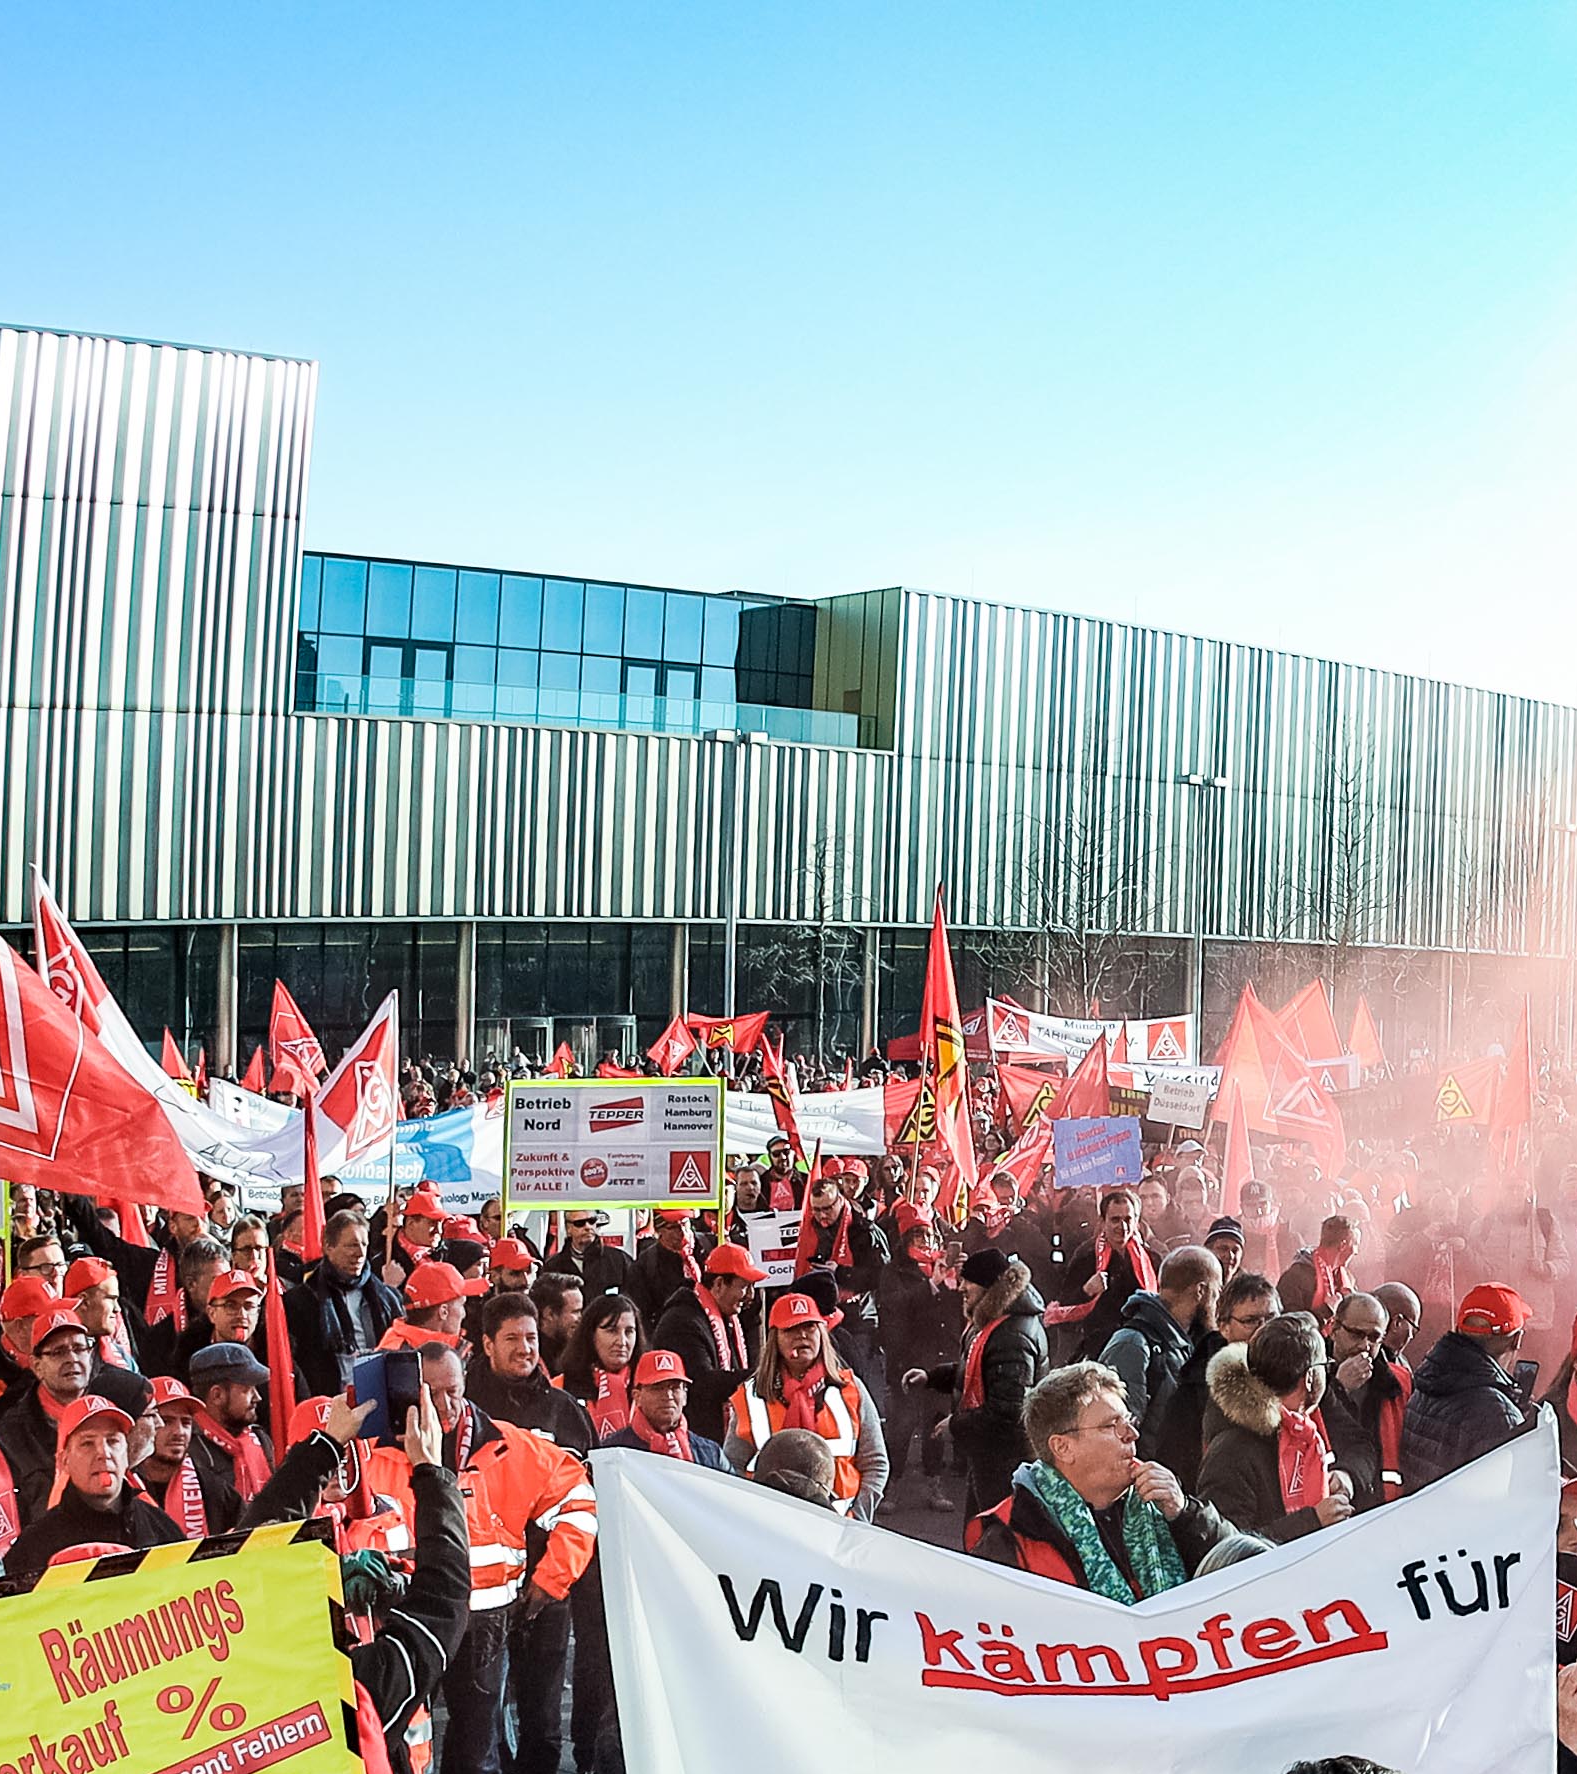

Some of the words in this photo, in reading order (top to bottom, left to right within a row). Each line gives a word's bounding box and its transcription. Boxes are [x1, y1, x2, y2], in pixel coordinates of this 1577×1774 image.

[515, 1098, 572, 1110] Betrieb
[667, 1095, 711, 1103] Rostock
[589, 1110, 644, 1120] TEPPER
[665, 1108, 712, 1119] Hamburg
[524, 1119, 561, 1131] Nord
[664, 1122, 713, 1131] Hannover
[719, 1573, 889, 1662] Wir
[914, 1596, 1378, 1700] kämpfen
[1398, 1549, 1522, 1621] für
[38, 1578, 245, 1704] Räumungs
[155, 1675, 248, 1741] %
[231, 1711, 325, 1767] Fehlern
